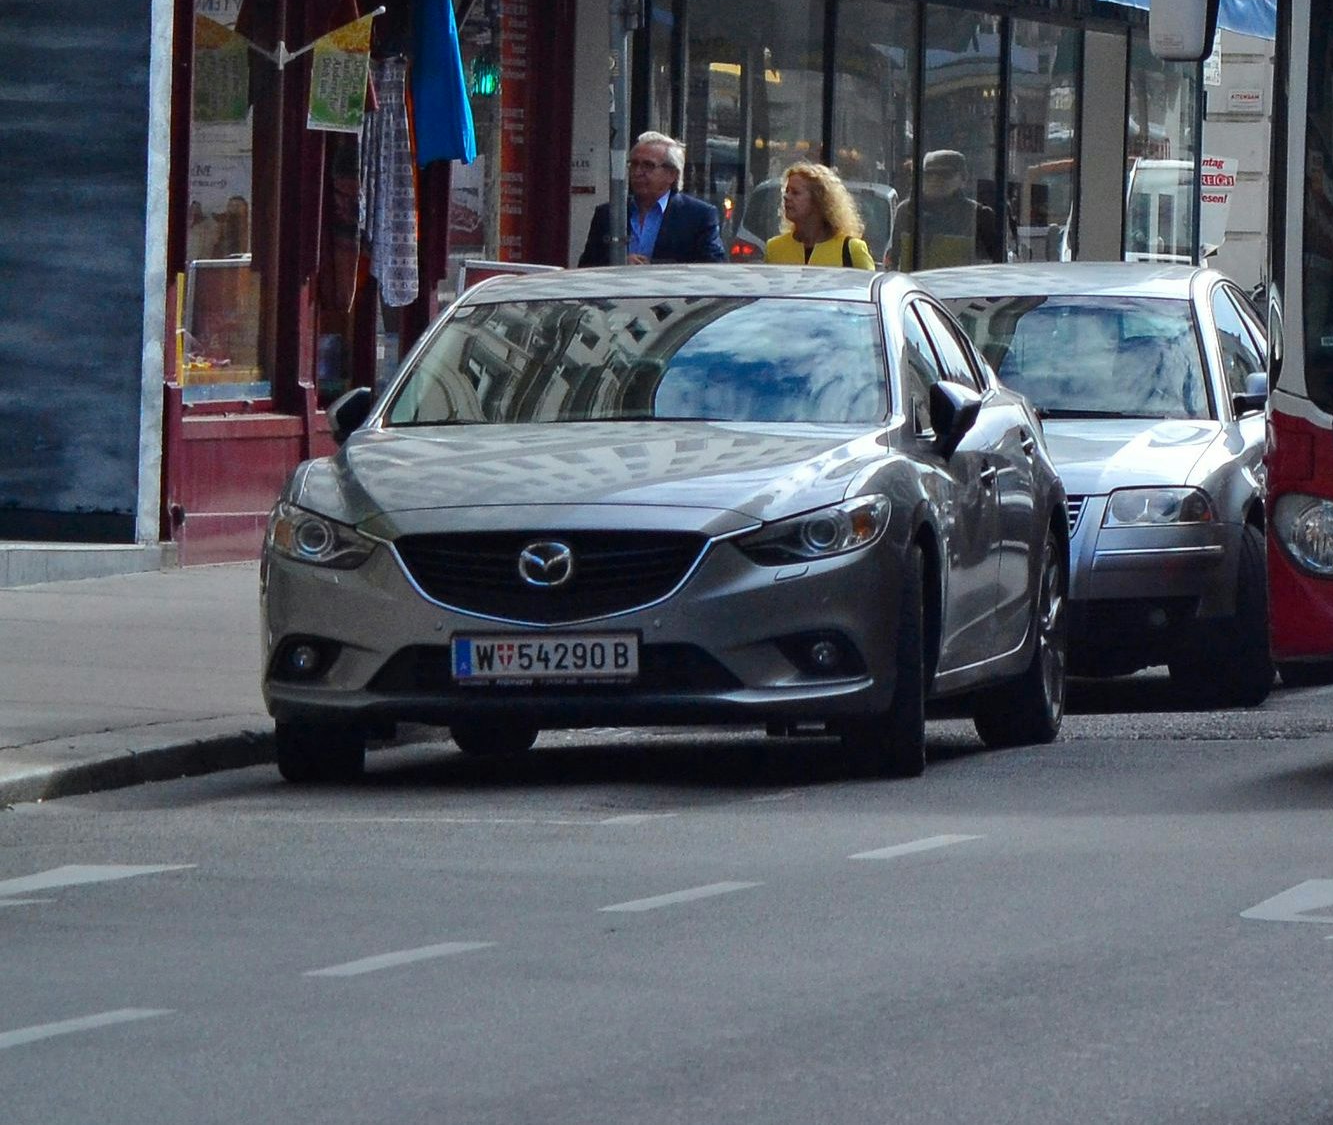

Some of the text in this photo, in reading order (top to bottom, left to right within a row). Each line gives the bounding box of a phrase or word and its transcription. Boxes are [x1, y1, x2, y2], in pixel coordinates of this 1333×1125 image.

[475, 644, 496, 671] W
[518, 642, 606, 671] 54290
[614, 642, 630, 669] B
